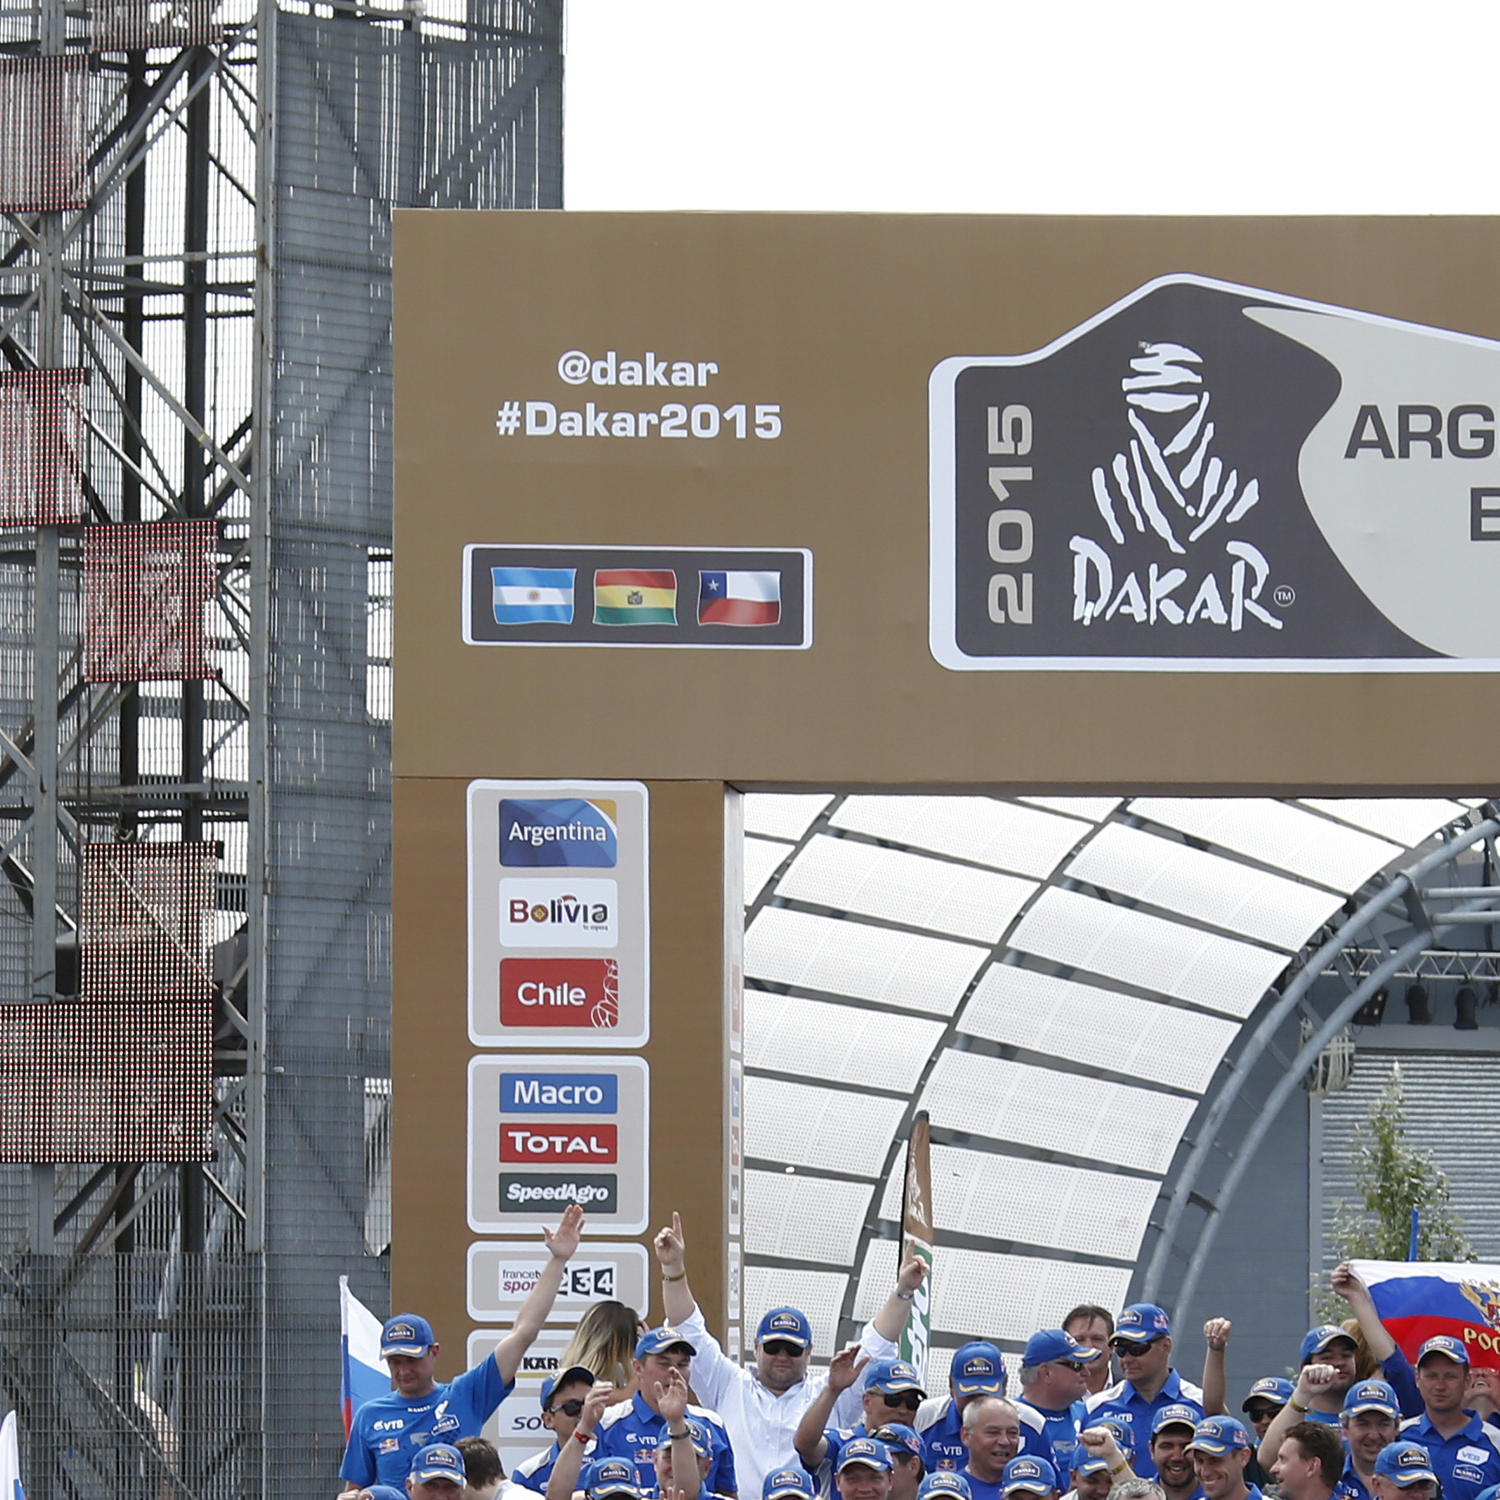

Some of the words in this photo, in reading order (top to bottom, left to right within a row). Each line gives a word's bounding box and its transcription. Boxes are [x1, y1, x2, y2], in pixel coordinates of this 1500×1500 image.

[557, 350, 718, 388] @dakar
[496, 401, 782, 440] #Dakar2015
[987, 403, 1034, 625] 2015
[1069, 535, 1283, 631] DAKAR
[509, 821, 607, 847] Argentina
[509, 895, 608, 924] Bolivia
[517, 983, 586, 1007] Chile
[514, 1080, 603, 1106] Macro
[509, 1131, 608, 1154] TOTAL
[507, 1182, 609, 1205] SpeedAgro
[598, 1272, 613, 1292] 4
[384, 1419, 404, 1430] VTB
[638, 1435, 657, 1445] VTB
[943, 1445, 962, 1455] VTB
[1462, 1451, 1481, 1461] VEB
